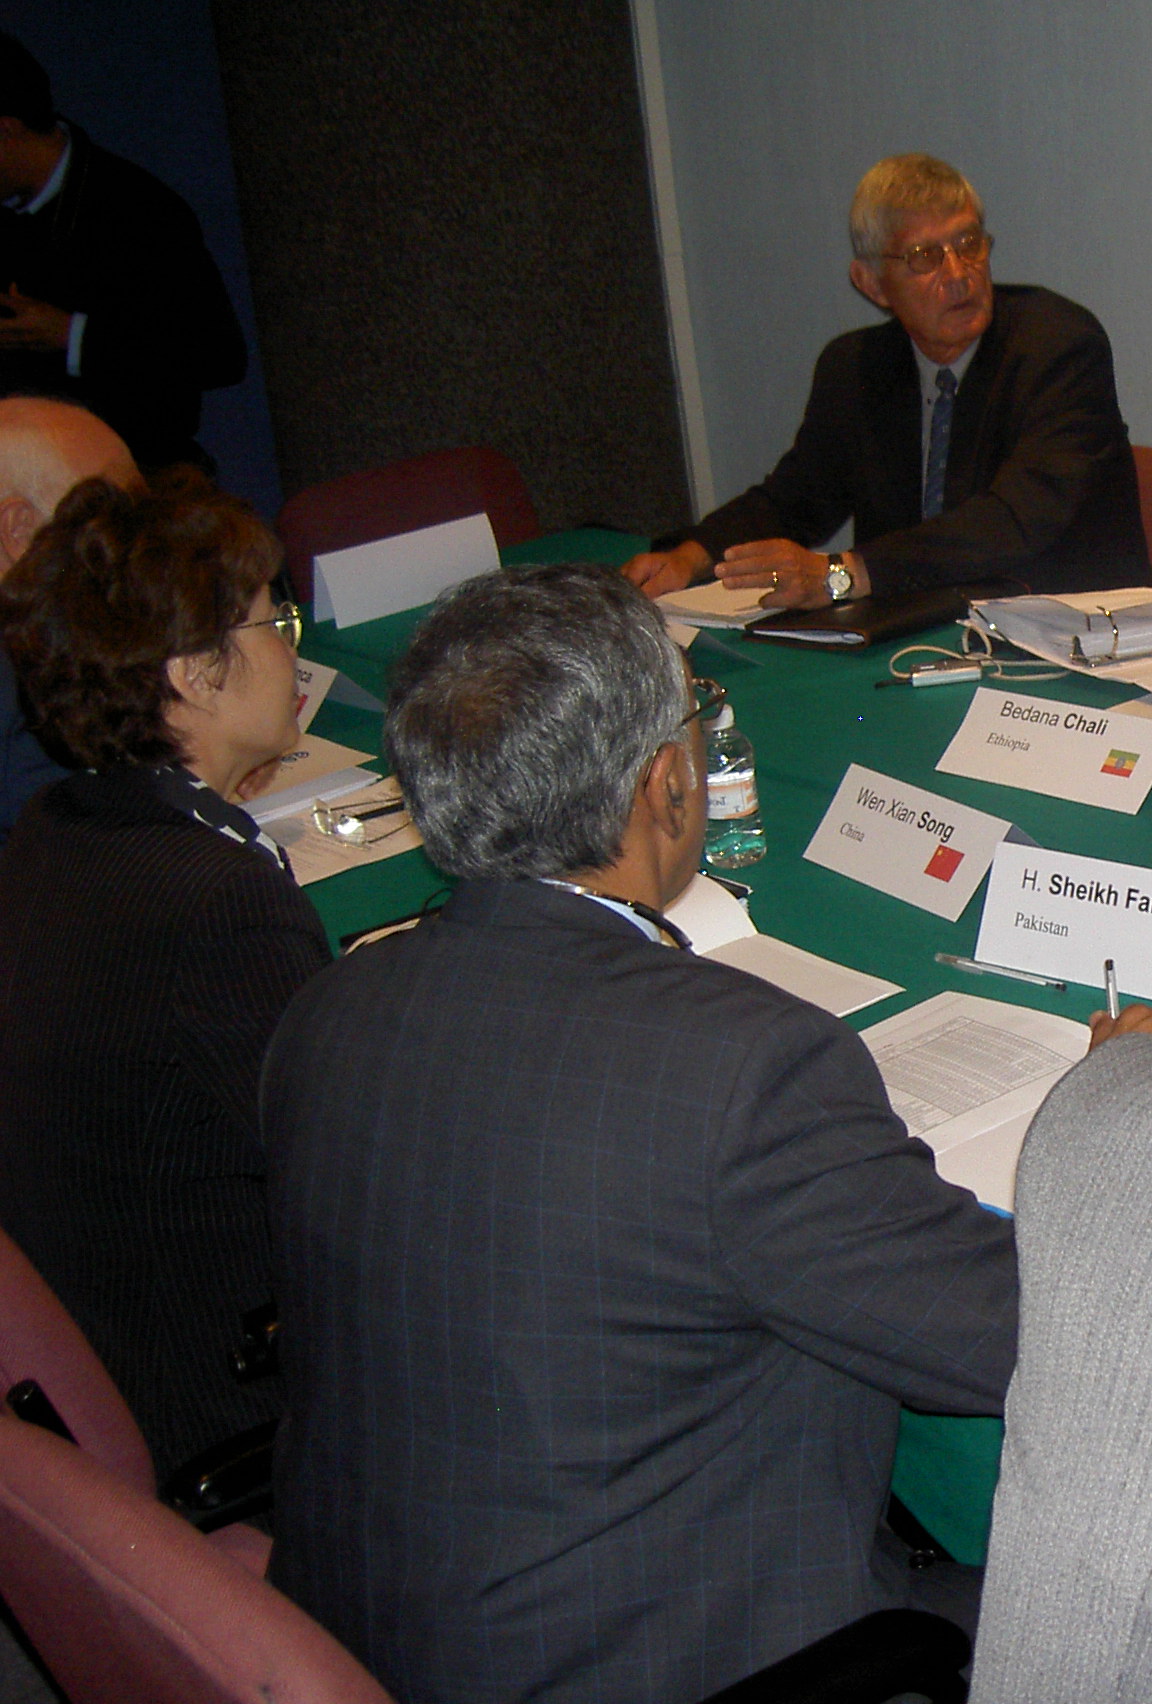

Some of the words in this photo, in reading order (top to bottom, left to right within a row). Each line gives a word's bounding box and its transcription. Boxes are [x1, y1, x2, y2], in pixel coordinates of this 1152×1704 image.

[1000, 700, 1060, 727] Bedana
[1063, 713, 1109, 737] Chali
[986, 732, 1031, 752] Ethiopia
[856, 786, 886, 813] Wen
[884, 798, 917, 825] Xian
[917, 811, 955, 843] Song
[839, 822, 865, 843] China
[1021, 869, 1041, 892] H.
[1049, 873, 1119, 907] Sheikh
[1014, 912, 1070, 938] Pakistan
